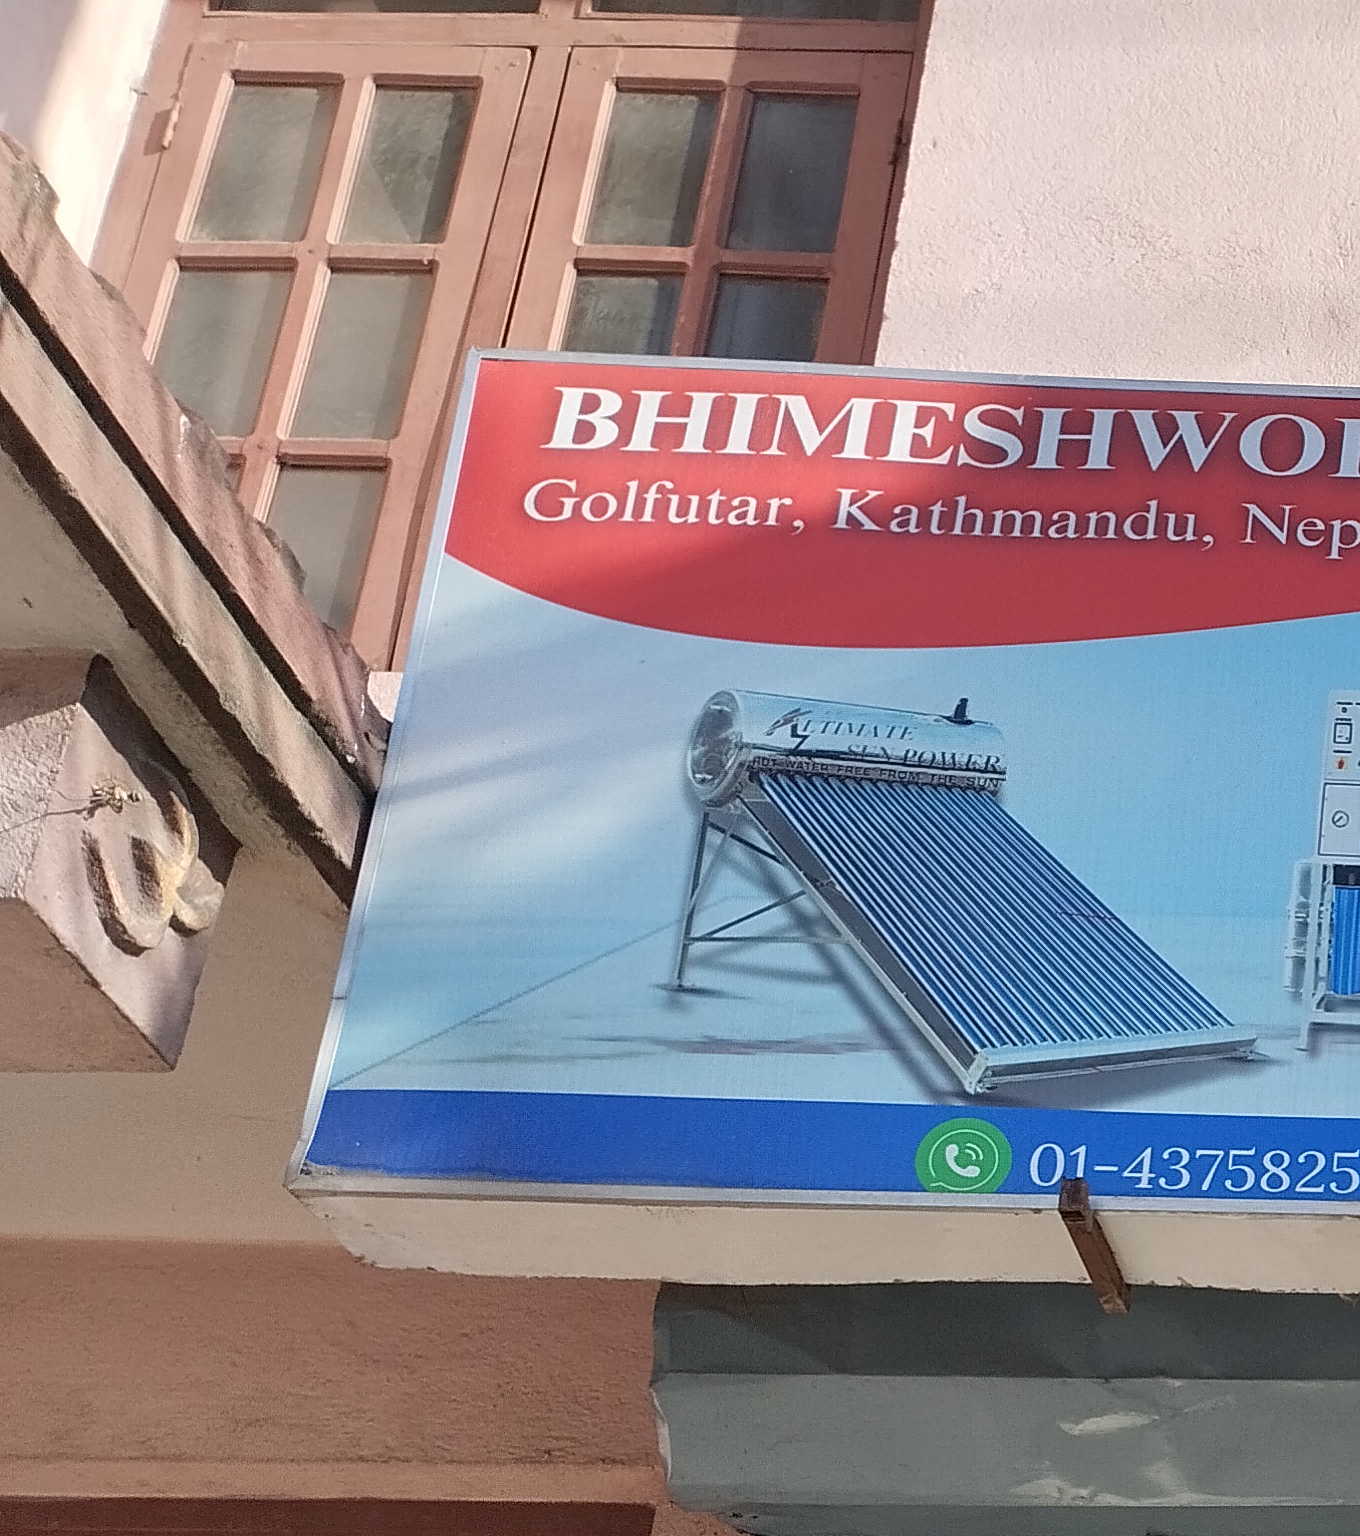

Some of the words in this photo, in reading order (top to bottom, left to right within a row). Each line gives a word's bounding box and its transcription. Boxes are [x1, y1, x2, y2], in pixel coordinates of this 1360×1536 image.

[523, 477, 806, 536] Golfutar,
[833, 487, 1214, 551] Kathmandu,
[903, 749, 1000, 772] POWER
[836, 764, 873, 777] FREE
[880, 769, 921, 781] FROM
[931, 774, 957, 786] THE
[966, 778, 999, 789] SUN
